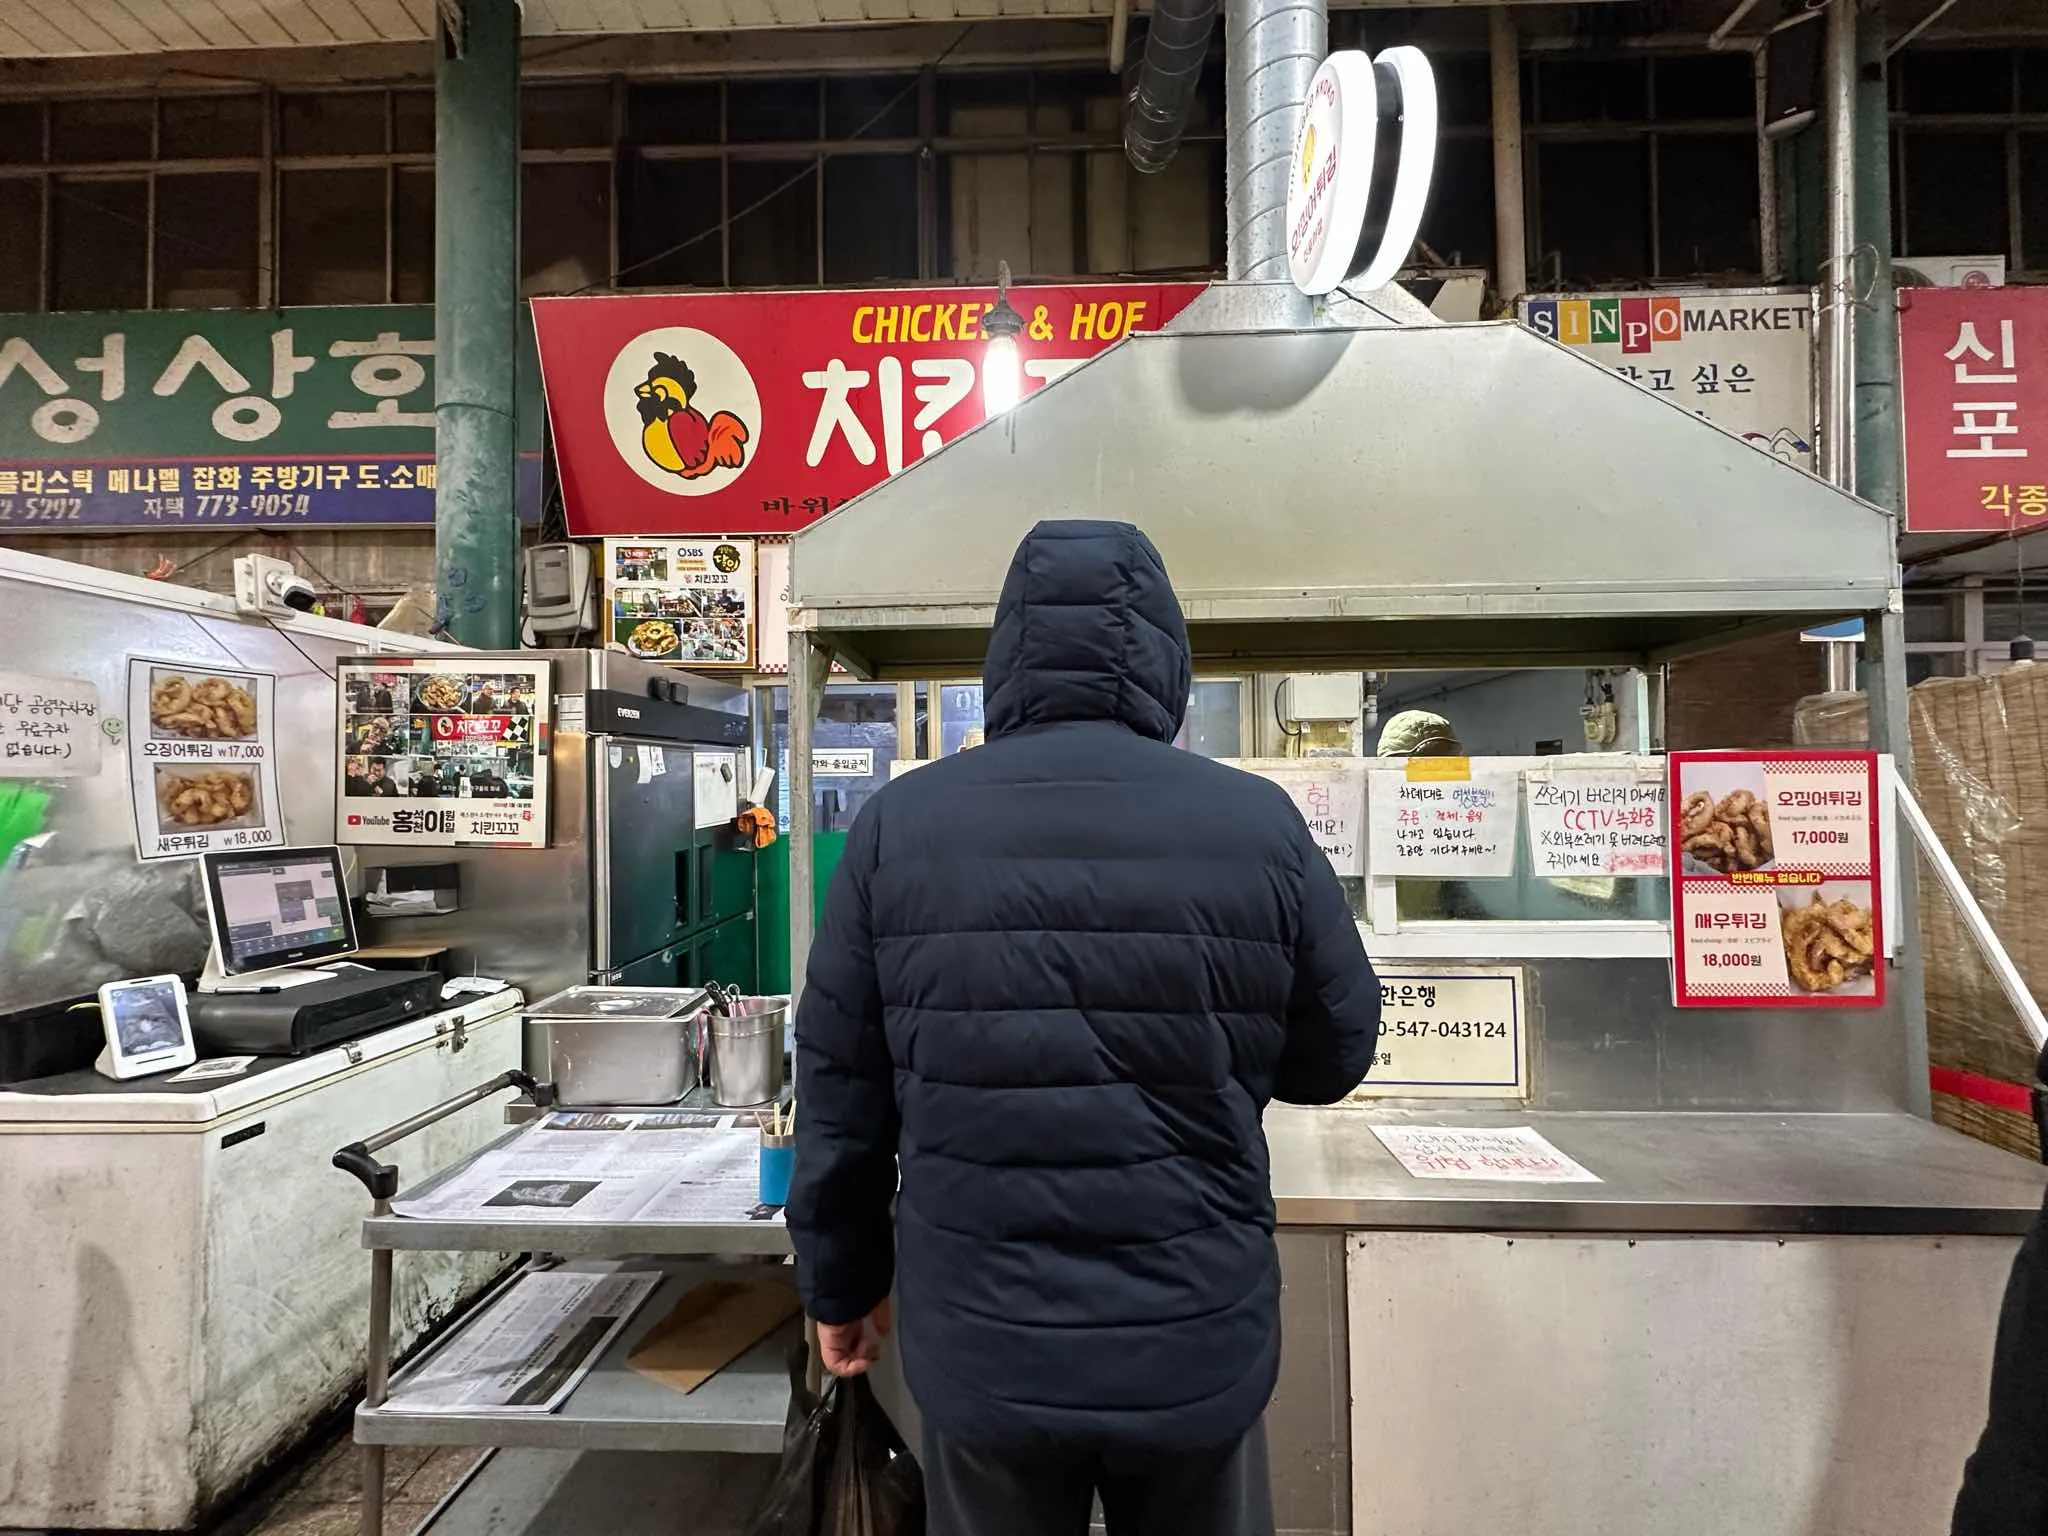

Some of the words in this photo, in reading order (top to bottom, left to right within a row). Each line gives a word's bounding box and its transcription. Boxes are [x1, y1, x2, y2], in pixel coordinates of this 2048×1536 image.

[1029, 304, 1054, 342] &
[1070, 301, 1147, 340] HOF
[1692, 362, 1755, 394] 싶은
[192, 466, 242, 491] 잡화
[250, 465, 350, 490] 주방기구
[143, 497, 184, 519] 자택
[196, 494, 310, 517] 773-9054
[1981, 484, 2047, 516] 각종
[143, 742, 213, 758] 오징어튀김
[1399, 786, 1444, 801] 차례대로
[1534, 786, 1580, 806] 쓰레기
[1586, 787, 1627, 805] 버리지
[1631, 787, 1666, 802] 마세요
[1778, 791, 1862, 807] 오징어튀김
[362, 815, 391, 826] YouTube
[470, 821, 520, 835] 치킨꼬꼬
[1397, 828, 1425, 841] 나가고
[1433, 827, 1476, 841] 있습니다
[1792, 831, 1849, 845] 17,000원
[157, 834, 210, 852] 새우튀김
[1731, 872, 1774, 884] 반반메뉴
[1777, 872, 1821, 884] 없습니다
[1694, 913, 1768, 929] 새우튀김
[1702, 953, 1763, 968] 18,000원
